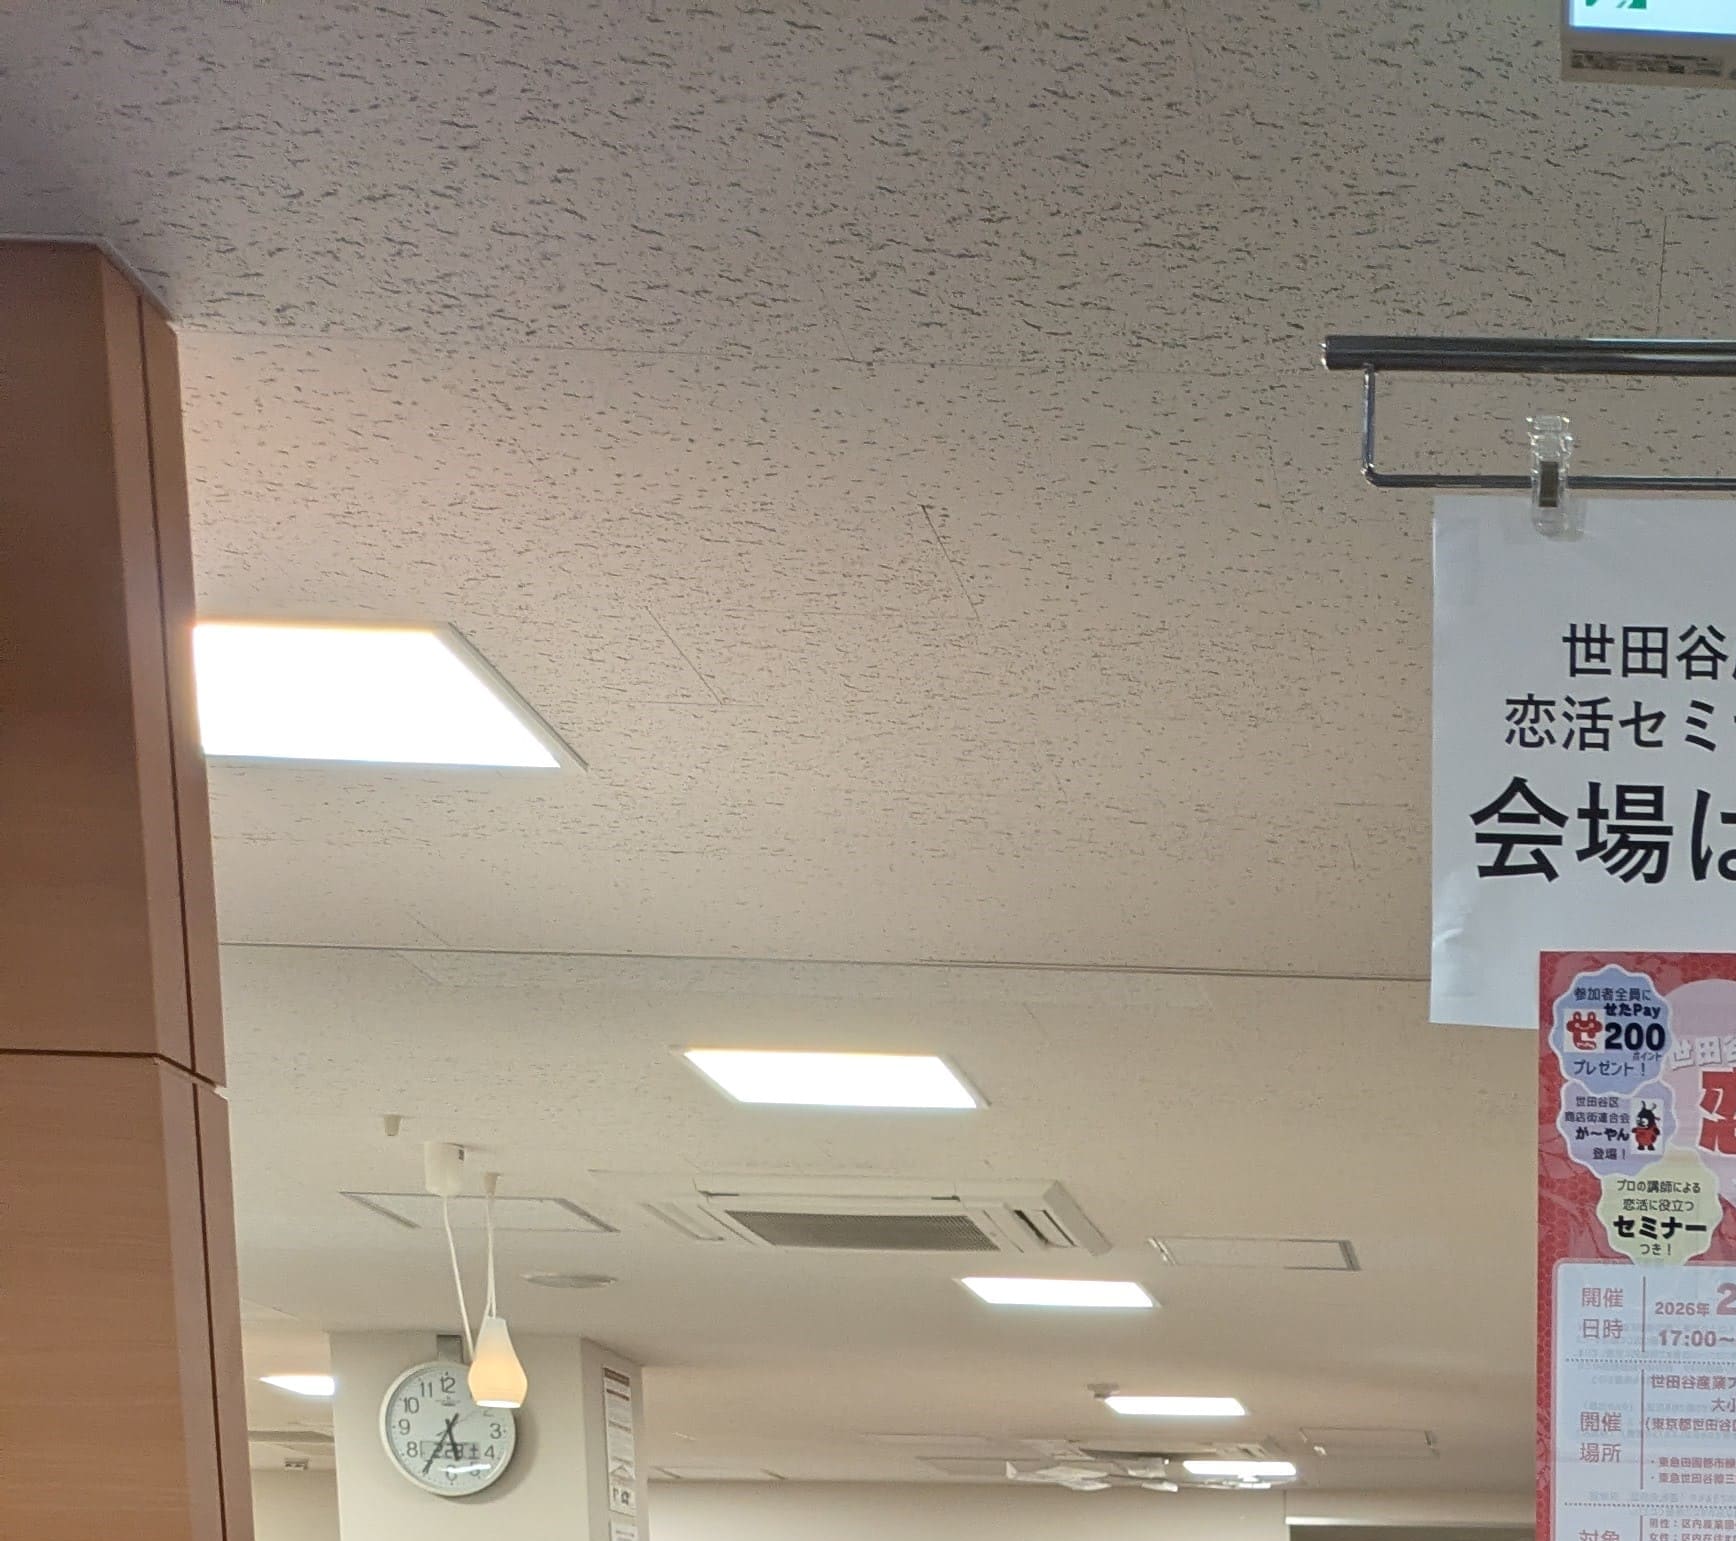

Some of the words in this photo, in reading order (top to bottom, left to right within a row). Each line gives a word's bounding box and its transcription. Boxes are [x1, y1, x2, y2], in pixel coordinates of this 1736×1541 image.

[1574, 988, 1651, 1001] 参加者全員に
[1605, 1003, 1660, 1018] せたPay
[1605, 1022, 1665, 1050] 200
[1632, 1052, 1662, 1061] ポイント
[1574, 1060, 1645, 1076] プレゼント！
[1576, 1097, 1619, 1108] 世田谷区
[1565, 1112, 1630, 1124] 商店街連合会
[1593, 1148, 1626, 1160] 登場！
[1617, 1180, 1701, 1193] プロの講師による
[1623, 1199, 1694, 1212] 恋活に役立つ
[1613, 1215, 1707, 1239] セミナー
[1640, 1244, 1672, 1255] つき！
[1582, 1288, 1624, 1308] 開催
[1582, 1319, 1624, 1340] 日時
[421, 1382, 432, 1398] 11
[441, 1376, 456, 1393] 12
[404, 1397, 420, 1413] 10
[398, 1419, 410, 1435] 9
[1580, 1411, 1622, 1432] 開催
[490, 1423, 502, 1439] 3
[407, 1441, 418, 1457] 8
[484, 1445, 495, 1459] 4
[1580, 1442, 1622, 1463] 場所
